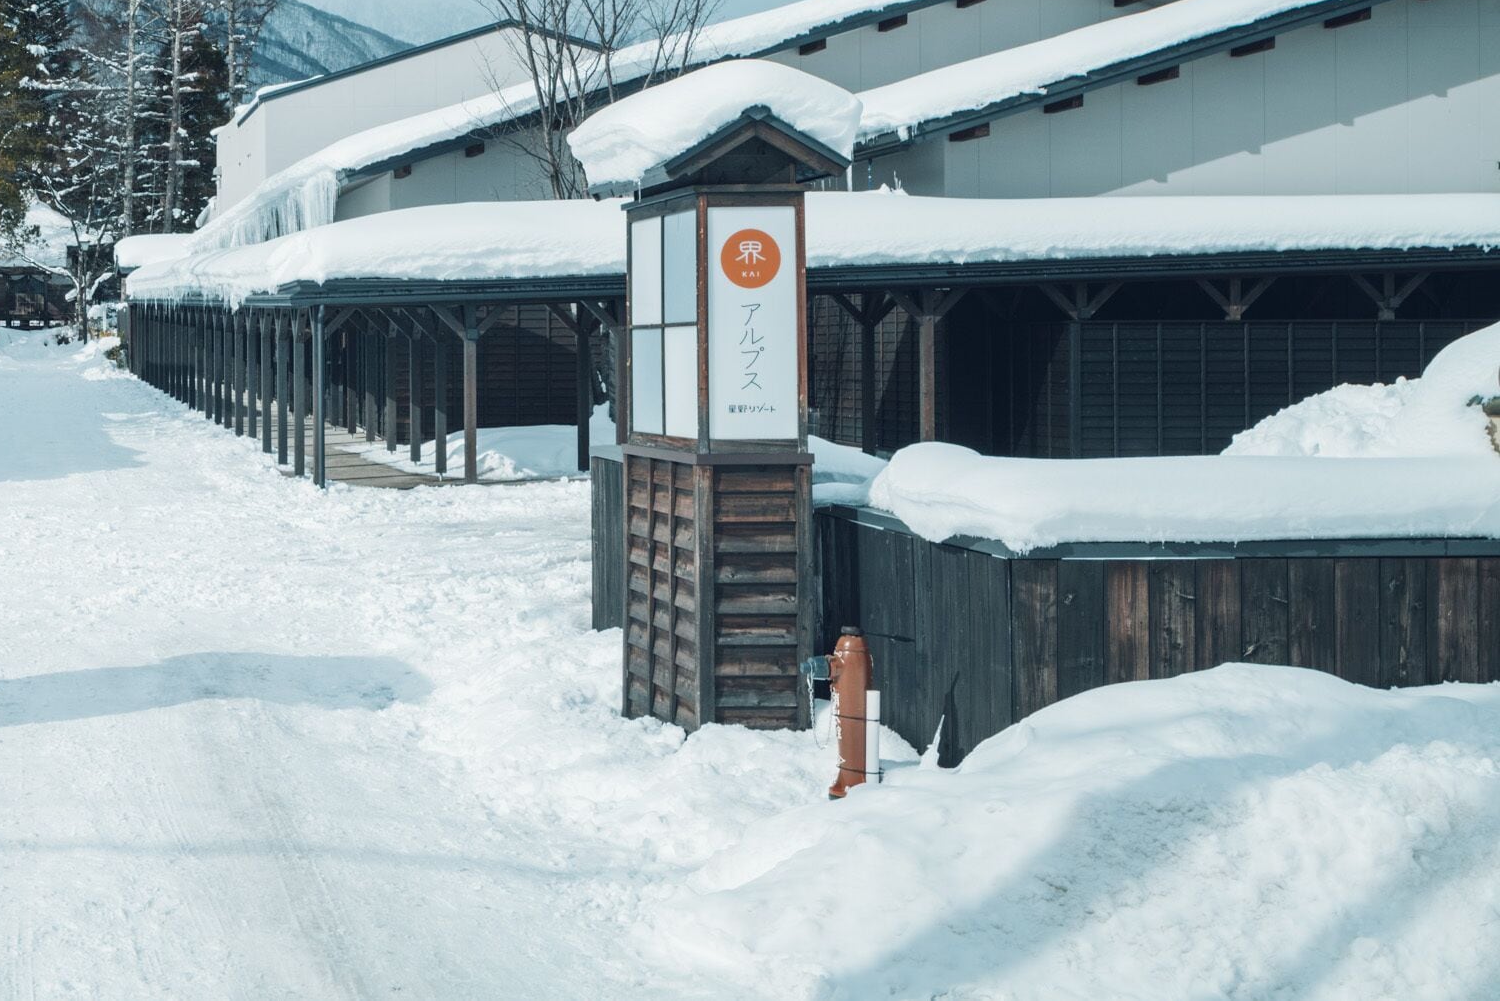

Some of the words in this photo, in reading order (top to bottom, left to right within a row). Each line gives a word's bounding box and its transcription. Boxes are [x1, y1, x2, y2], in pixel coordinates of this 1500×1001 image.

[735, 241, 766, 264] 界
[739, 303, 765, 390] アルプス
[728, 402, 776, 413] 星野リゾート
